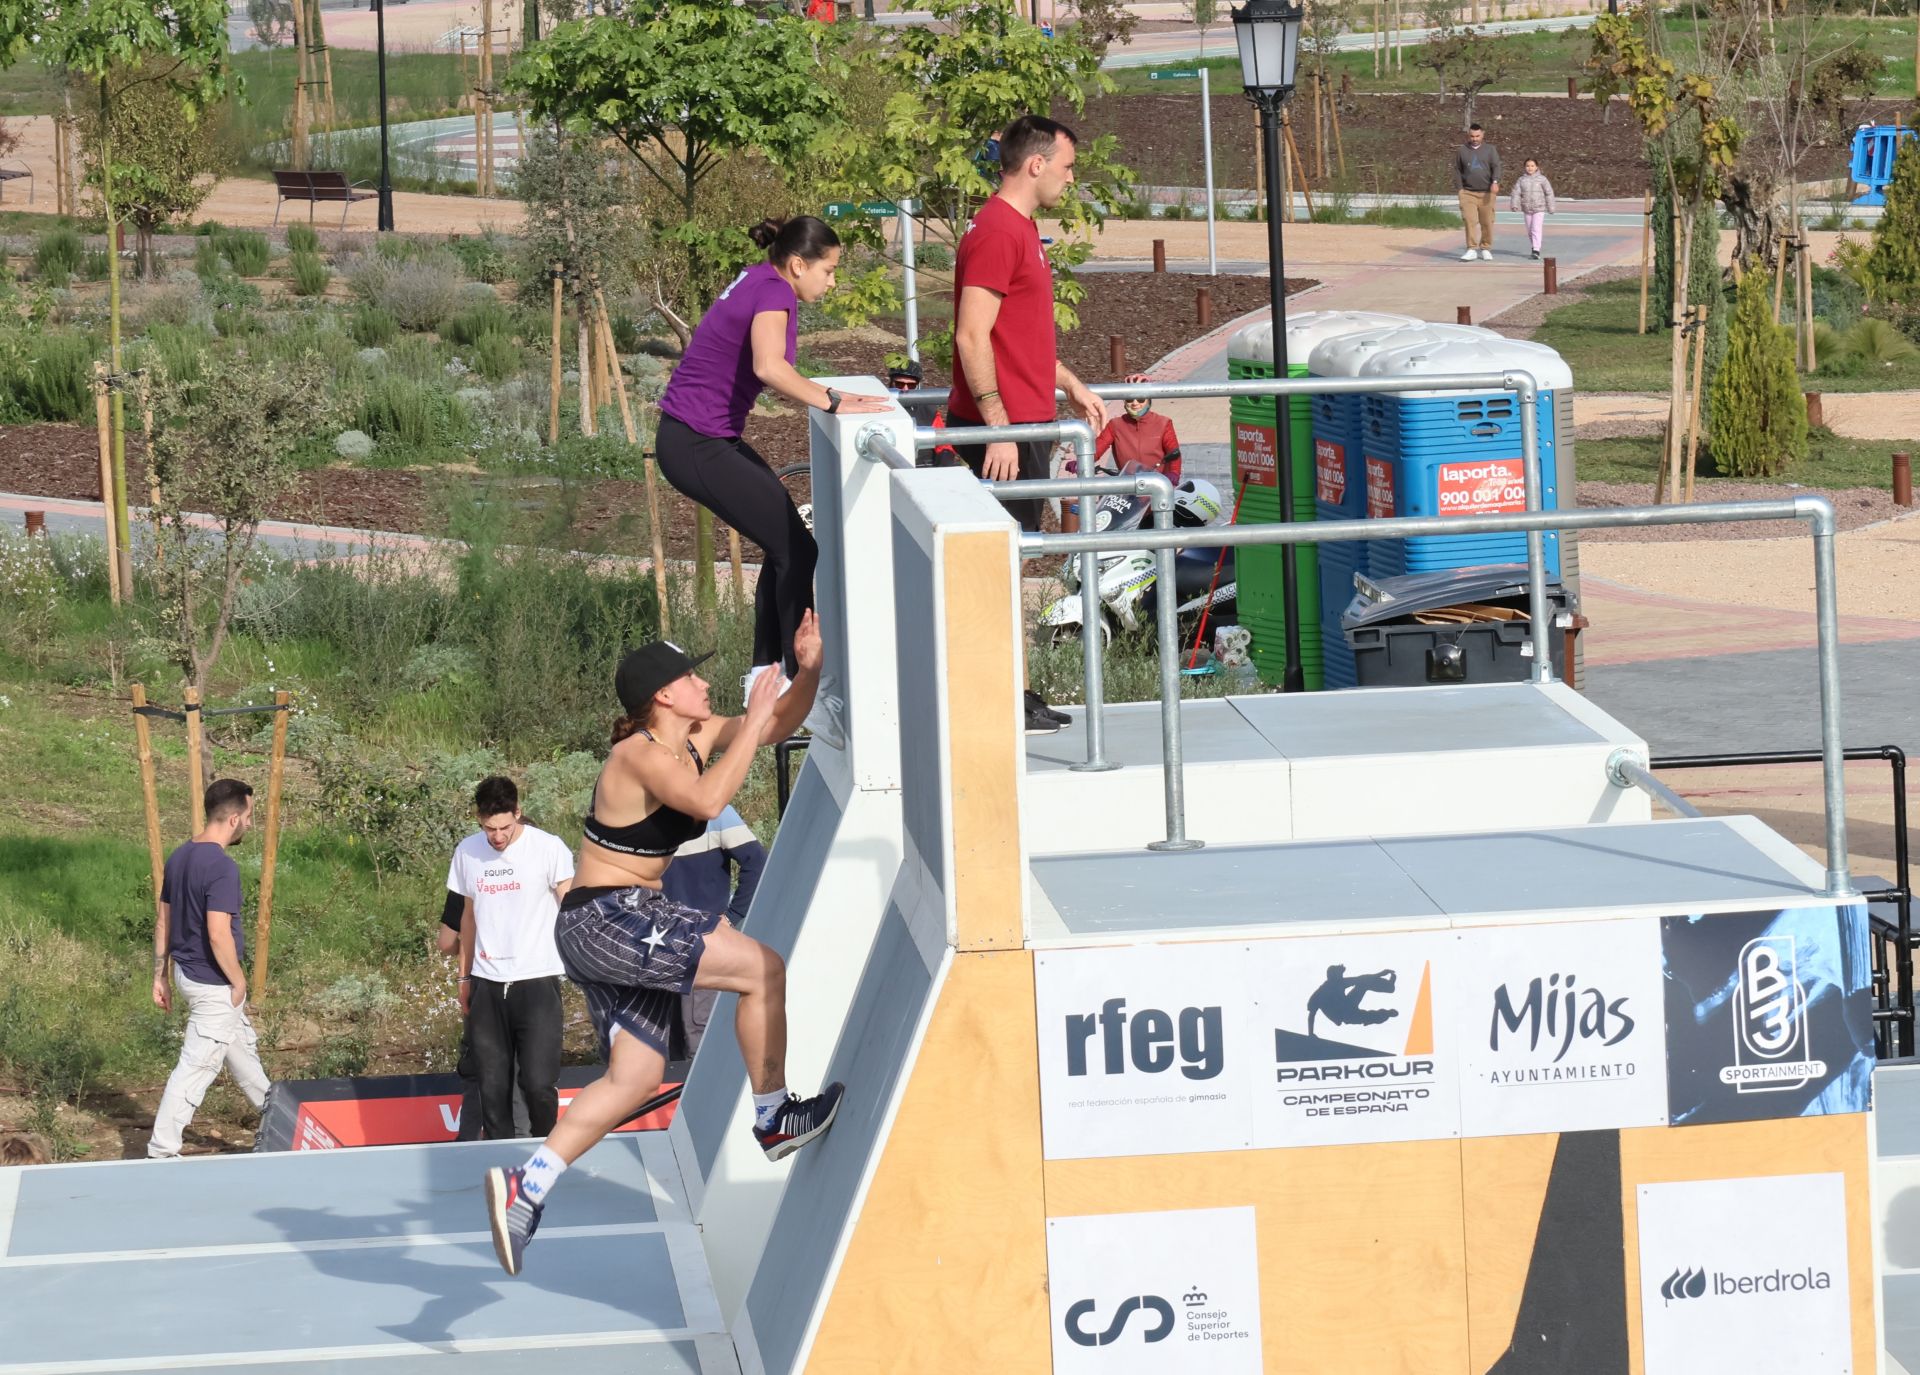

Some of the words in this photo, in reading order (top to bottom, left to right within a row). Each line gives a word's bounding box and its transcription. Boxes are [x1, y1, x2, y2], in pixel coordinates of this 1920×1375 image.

[1261, 454, 1275, 467] 006
[1440, 491, 1469, 505] 900
[1472, 487, 1500, 502] 001
[484, 868, 514, 877] EQUIPO
[476, 880, 521, 895] Vaguada
[1489, 973, 1635, 1063] Mijas
[1065, 997, 1224, 1080] rfeg
[1276, 1060, 1434, 1083] PARKOUR
[1490, 1062, 1635, 1084] AYUNTAMIENTO
[1725, 1062, 1822, 1081] SPORTAINMENT
[1188, 1092, 1227, 1103] gimnasia
[1283, 1088, 1430, 1106] CAMPEONATO
[1305, 1107, 1331, 1117] DE
[1333, 1101, 1409, 1116] ESPAÑA
[1713, 1267, 1831, 1296] Iberdrola
[1186, 1309, 1228, 1320] Consejo
[1187, 1321, 1231, 1333] Superior
[1187, 1333, 1201, 1342] de
[1203, 1331, 1249, 1342] Deportes
